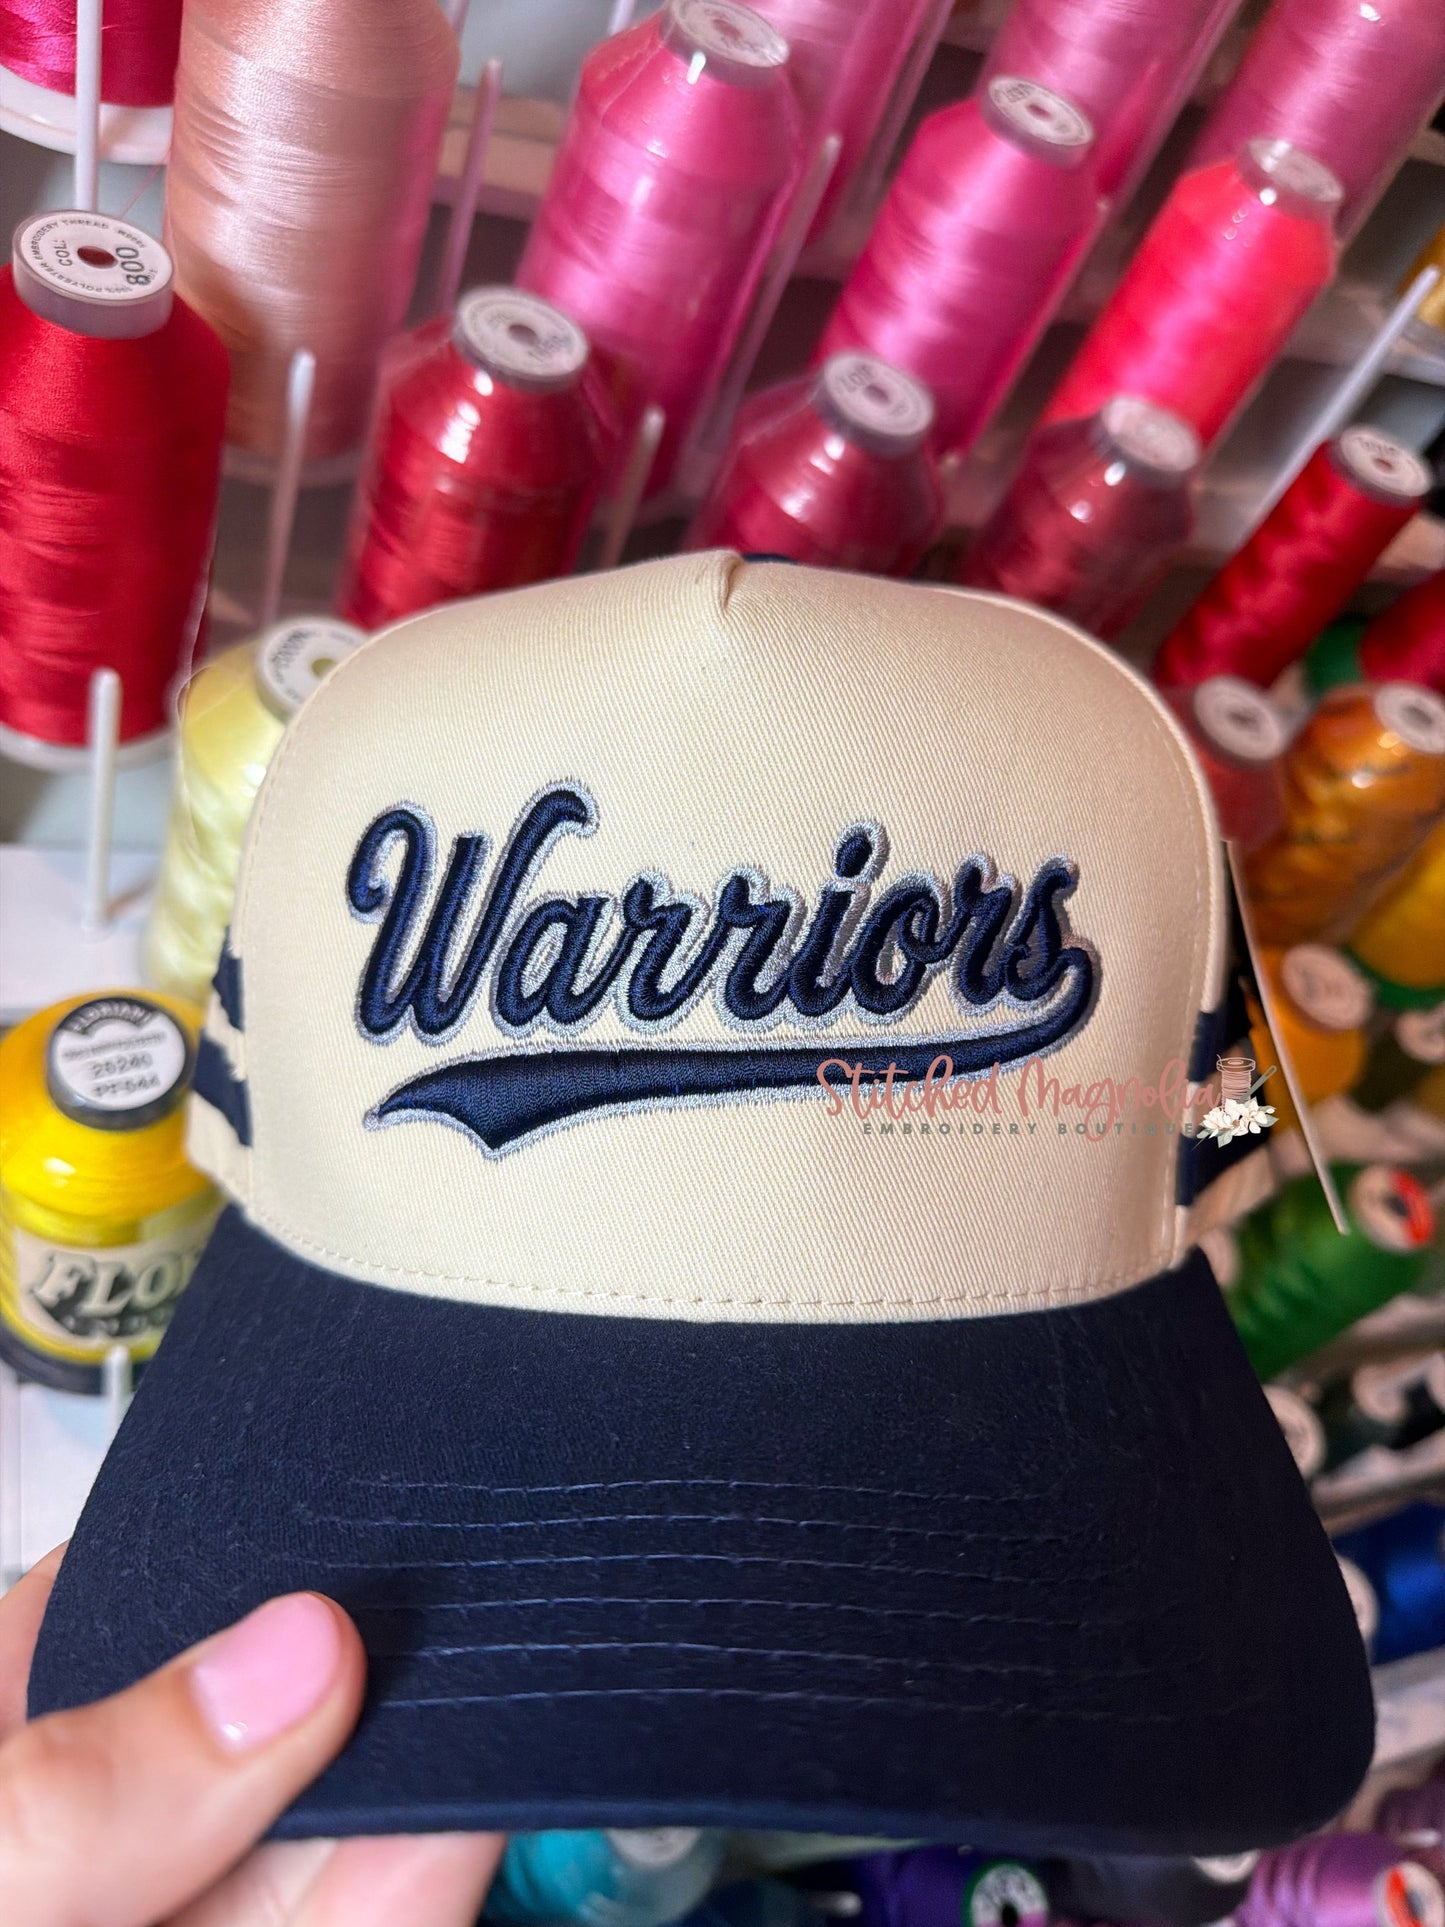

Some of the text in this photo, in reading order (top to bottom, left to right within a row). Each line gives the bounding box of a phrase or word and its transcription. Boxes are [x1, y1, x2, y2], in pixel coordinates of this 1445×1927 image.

[30, 220, 60, 261] EMBROIDERY
[61, 218, 110, 230] THREAD
[39, 261, 103, 294] POLYESTER
[115, 246, 152, 286] 800
[346, 778, 1101, 1046] Warriors
